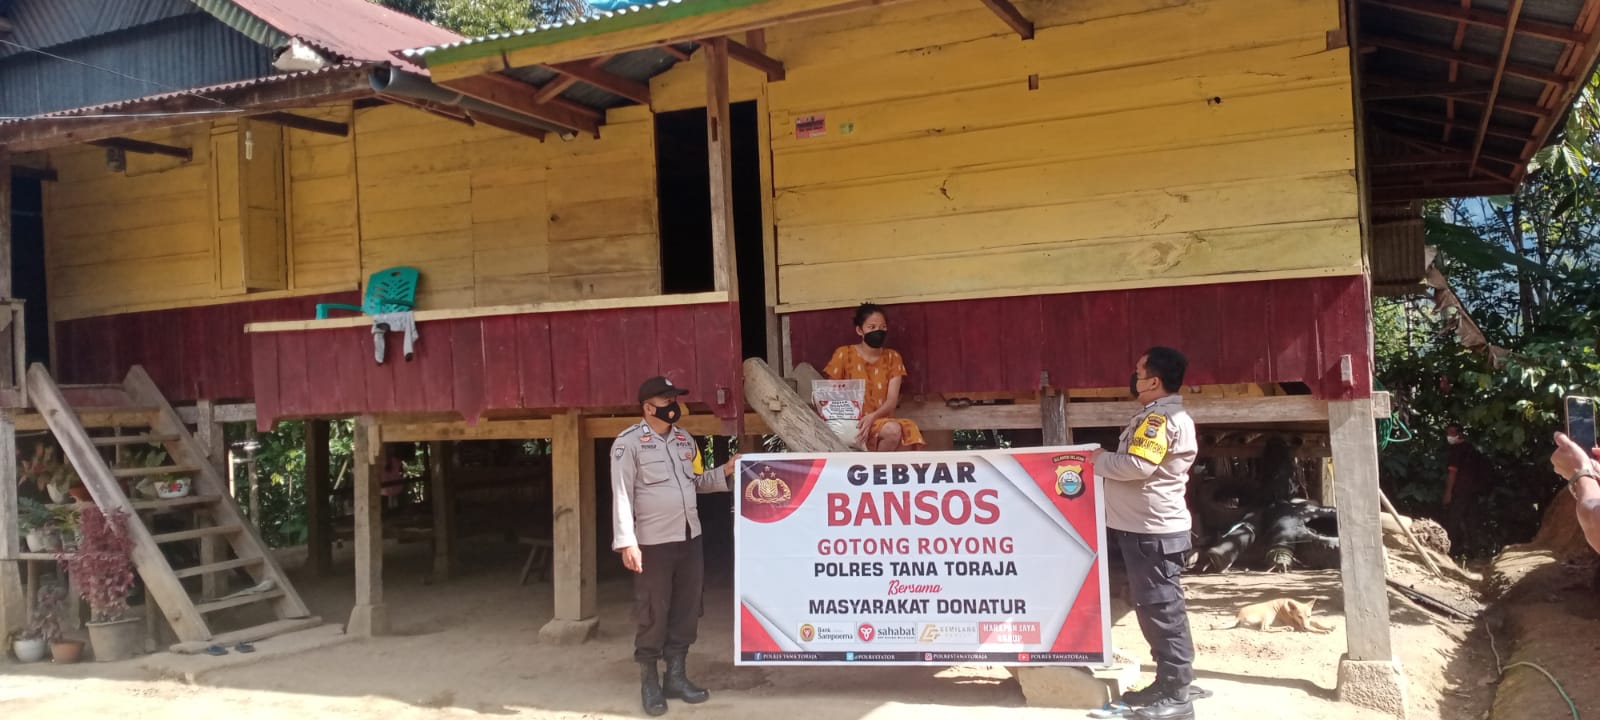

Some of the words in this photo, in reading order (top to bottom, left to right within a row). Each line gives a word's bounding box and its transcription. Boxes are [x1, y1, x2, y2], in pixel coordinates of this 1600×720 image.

[847, 462, 977, 486] GEBYAR
[827, 488, 1001, 527] BANSOS
[817, 538, 910, 556] GOTONG
[918, 536, 1015, 555] ROYONG
[814, 562, 884, 577] POLRES
[890, 561, 938, 577] TANA
[944, 561, 1018, 576] TORAJA
[888, 580, 942, 596] Bersama
[809, 599, 930, 615] MASYARAKAT
[937, 599, 1026, 615] DONATUR
[877, 626, 915, 636] sahabat
[1019, 623, 1036, 632] JAYA
[817, 632, 853, 640] Sampoerna
